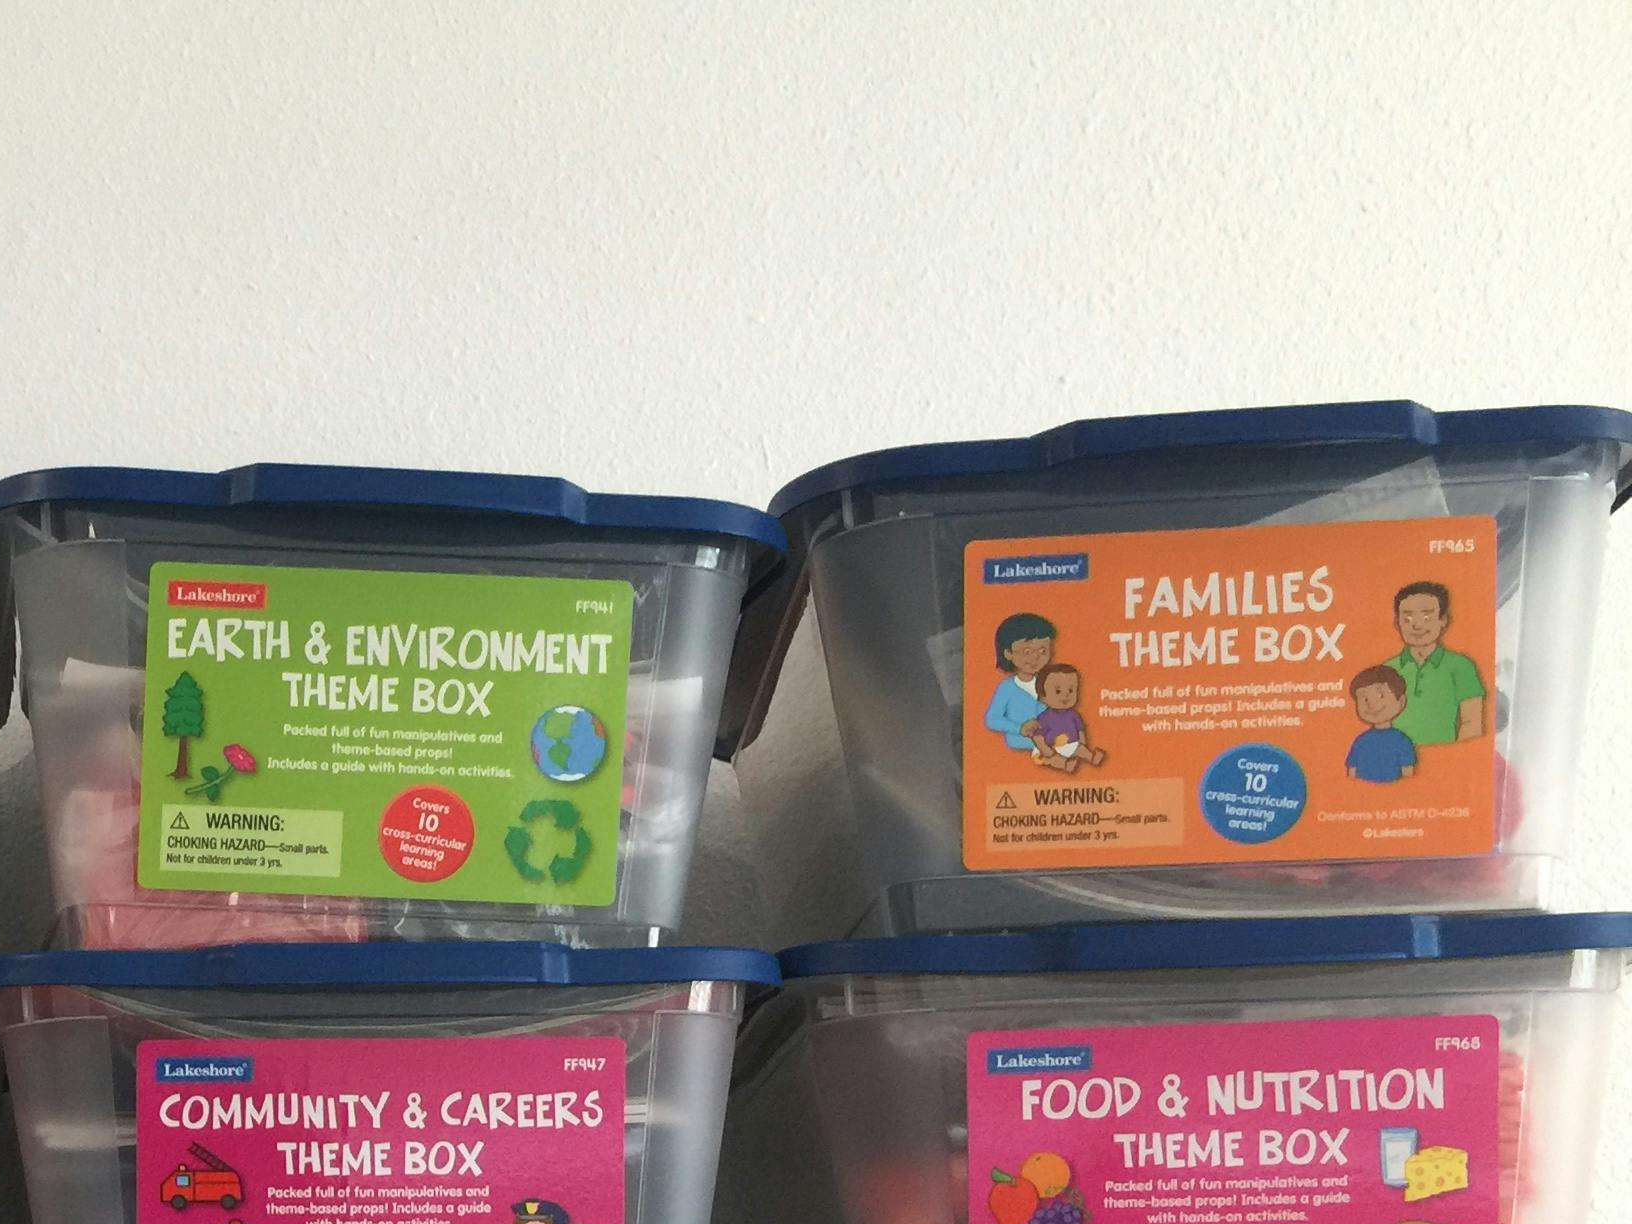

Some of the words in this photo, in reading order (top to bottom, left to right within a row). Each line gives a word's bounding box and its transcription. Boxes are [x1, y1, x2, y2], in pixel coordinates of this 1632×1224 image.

[1429, 539, 1475, 553] FF965
[993, 561, 1078, 578] Lakeshore
[176, 587, 256, 603] Lakeshore
[1125, 566, 1334, 619] FAMILIES
[576, 600, 613, 615] FF941
[168, 618, 289, 662] EARTH
[305, 621, 331, 665] &
[347, 624, 612, 675] ENVIRONMENT
[1110, 629, 1240, 667] THEME
[1255, 624, 1346, 663] BOX
[282, 673, 399, 713] THEME
[413, 679, 494, 718] BOX
[1034, 787, 1119, 806] WARNING:
[206, 813, 285, 832] WARNING:
[164, 1063, 244, 1077] Lakeshore
[564, 1058, 606, 1071] FF947
[996, 1053, 1083, 1068] Lakeshore
[1022, 1078, 1140, 1121] FOOD
[1157, 1073, 1189, 1118] &
[1208, 1067, 1444, 1116] NUTRITION
[160, 1092, 390, 1131] COMMUNITY
[404, 1093, 427, 1128] &
[441, 1090, 603, 1130] CAREERS
[1114, 1133, 1242, 1169] THEME
[1259, 1128, 1349, 1166] BOX
[277, 1142, 392, 1177] THEME
[405, 1140, 485, 1177] BOX
